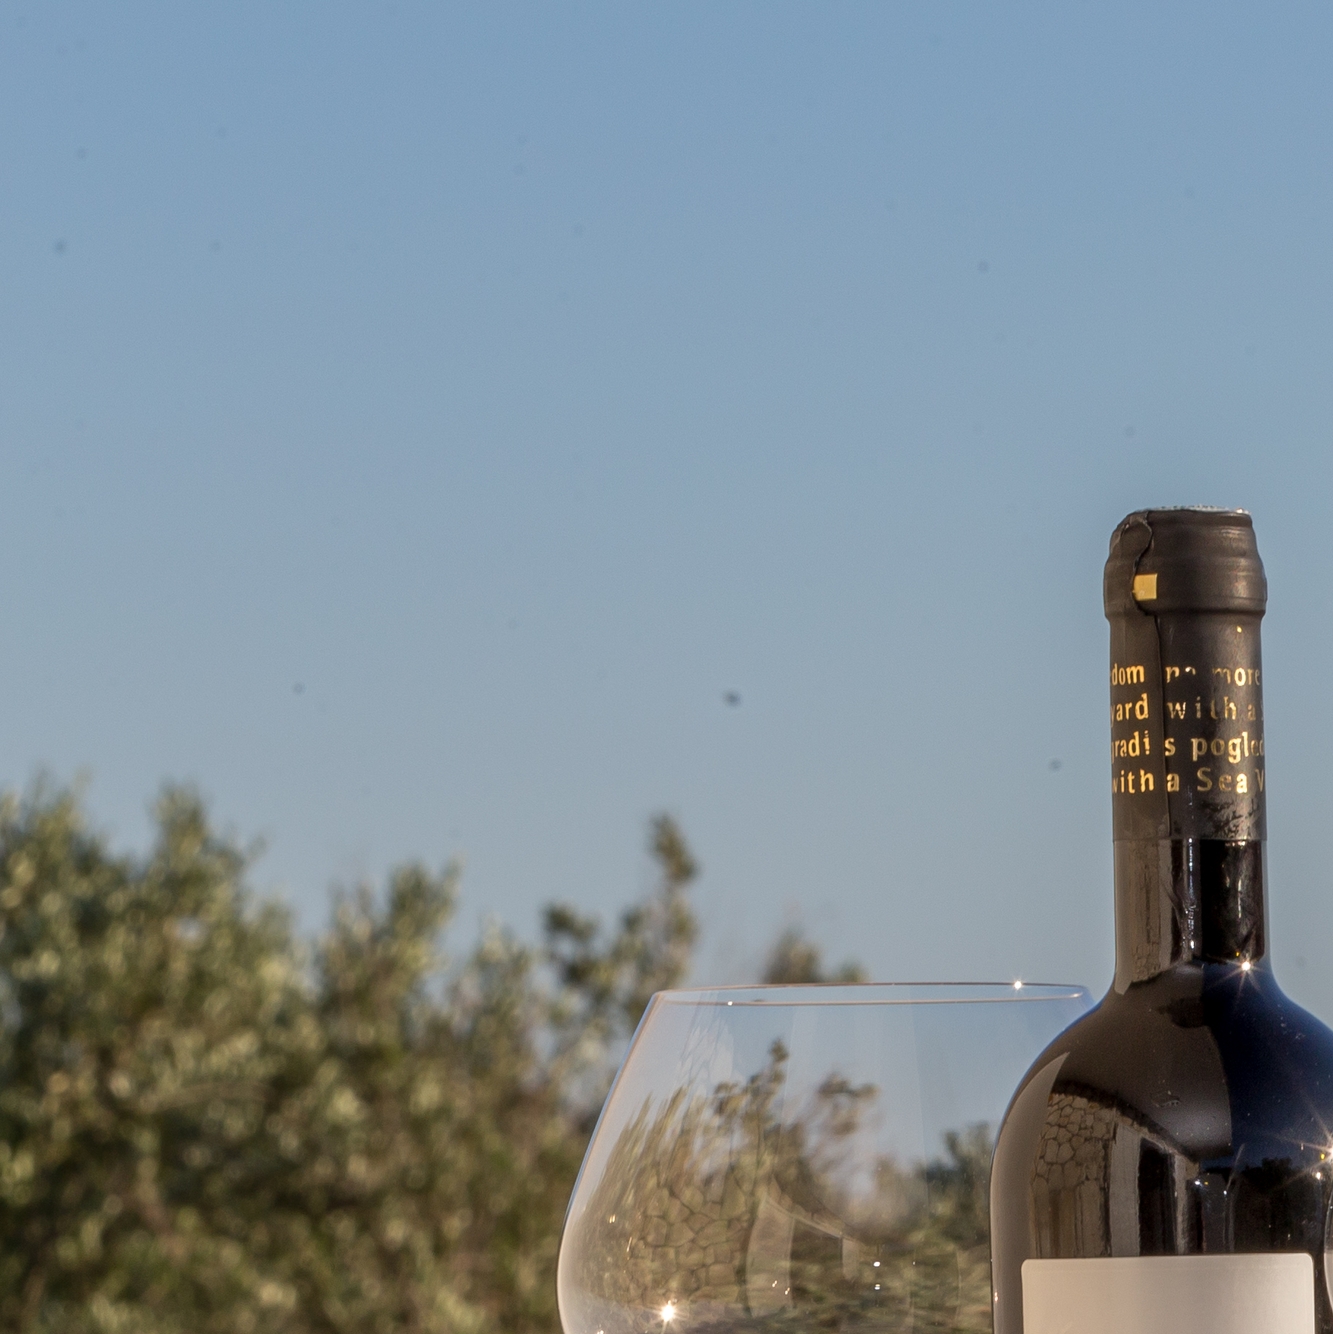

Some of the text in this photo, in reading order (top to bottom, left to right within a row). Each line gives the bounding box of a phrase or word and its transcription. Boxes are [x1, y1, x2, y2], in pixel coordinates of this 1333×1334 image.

[1165, 737, 1176, 756] s
[1167, 772, 1180, 793] a
[1197, 767, 1248, 793] Sea
